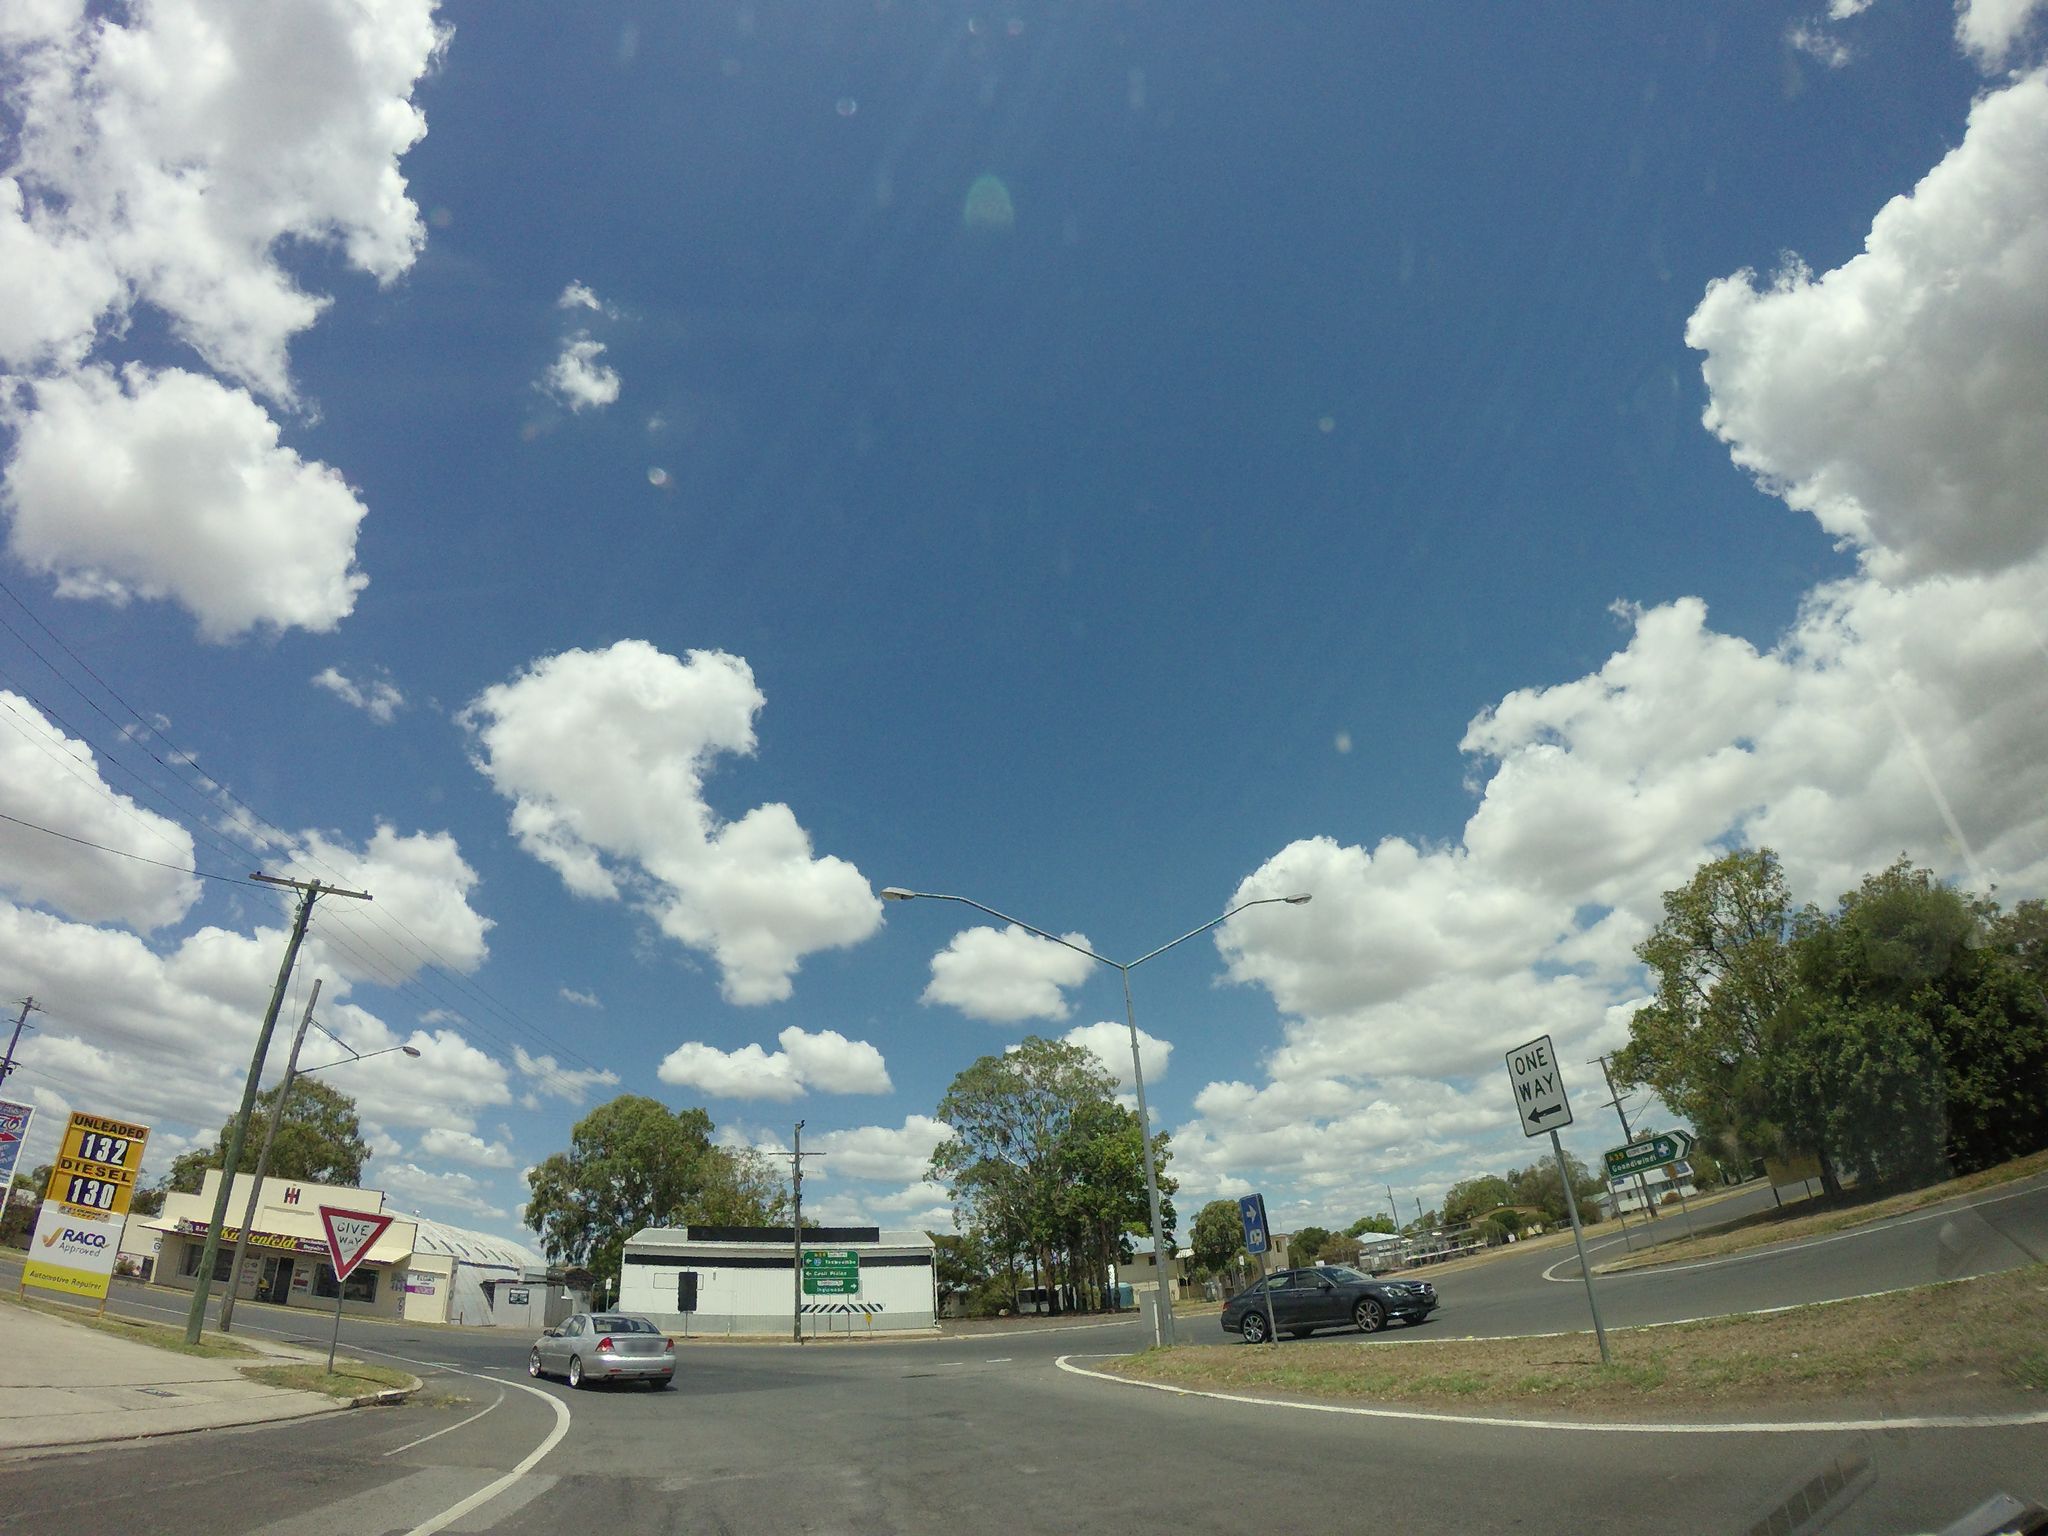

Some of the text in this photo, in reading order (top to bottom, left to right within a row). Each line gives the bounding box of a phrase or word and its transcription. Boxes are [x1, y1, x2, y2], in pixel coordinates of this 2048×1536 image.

[1515, 1047, 1548, 1075] ONE
[1519, 1073, 1553, 1102] WAY
[74, 1115, 144, 1139] UNLEADED
[84, 1134, 128, 1164] 132
[61, 1159, 131, 1182] DIESEL
[71, 1178, 115, 1209] 130
[62, 1228, 106, 1248] RACQ
[337, 1222, 370, 1236] GIVE
[59, 1242, 101, 1257] Approved
[339, 1236, 362, 1246] WAY
[29, 1270, 70, 1284] Automotive
[70, 1278, 101, 1290] Repairer
